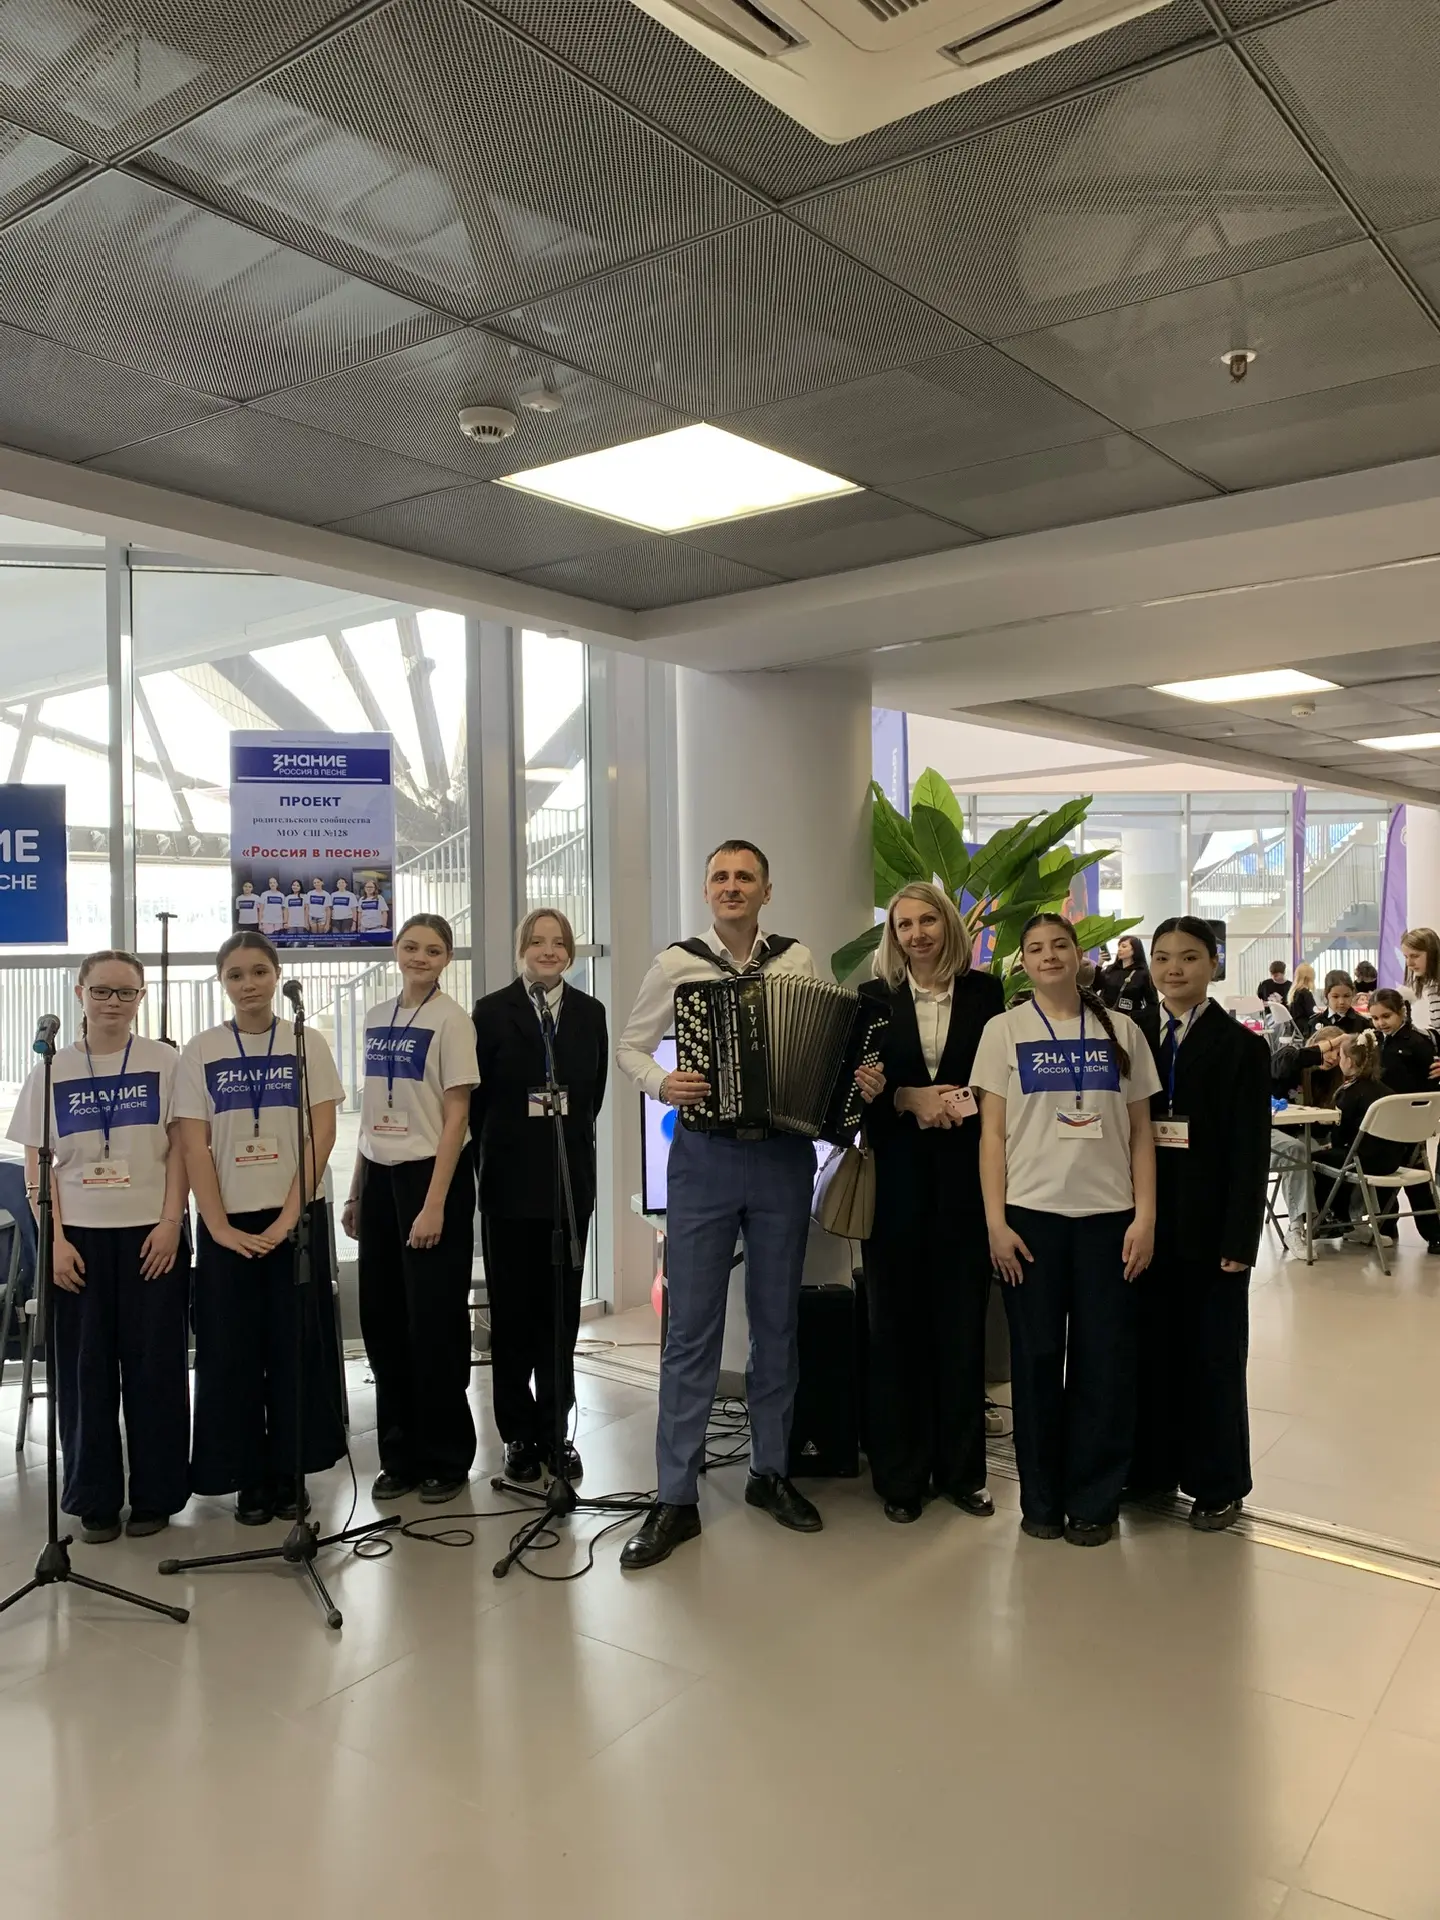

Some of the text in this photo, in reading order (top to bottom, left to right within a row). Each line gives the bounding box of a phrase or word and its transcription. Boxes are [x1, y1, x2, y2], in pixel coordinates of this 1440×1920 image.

[279, 796, 341, 807] ПРОЕКТ
[252, 816, 371, 825] родительского сообщества
[277, 829, 301, 837] МОУ
[322, 829, 349, 837] №128
[242, 845, 380, 858] «Россия в песне»
[748, 1004, 759, 1051] ТУЛА
[265, 1082, 292, 1090] ПЕСНЕ
[120, 1101, 148, 1110] ПЕСНЕ
